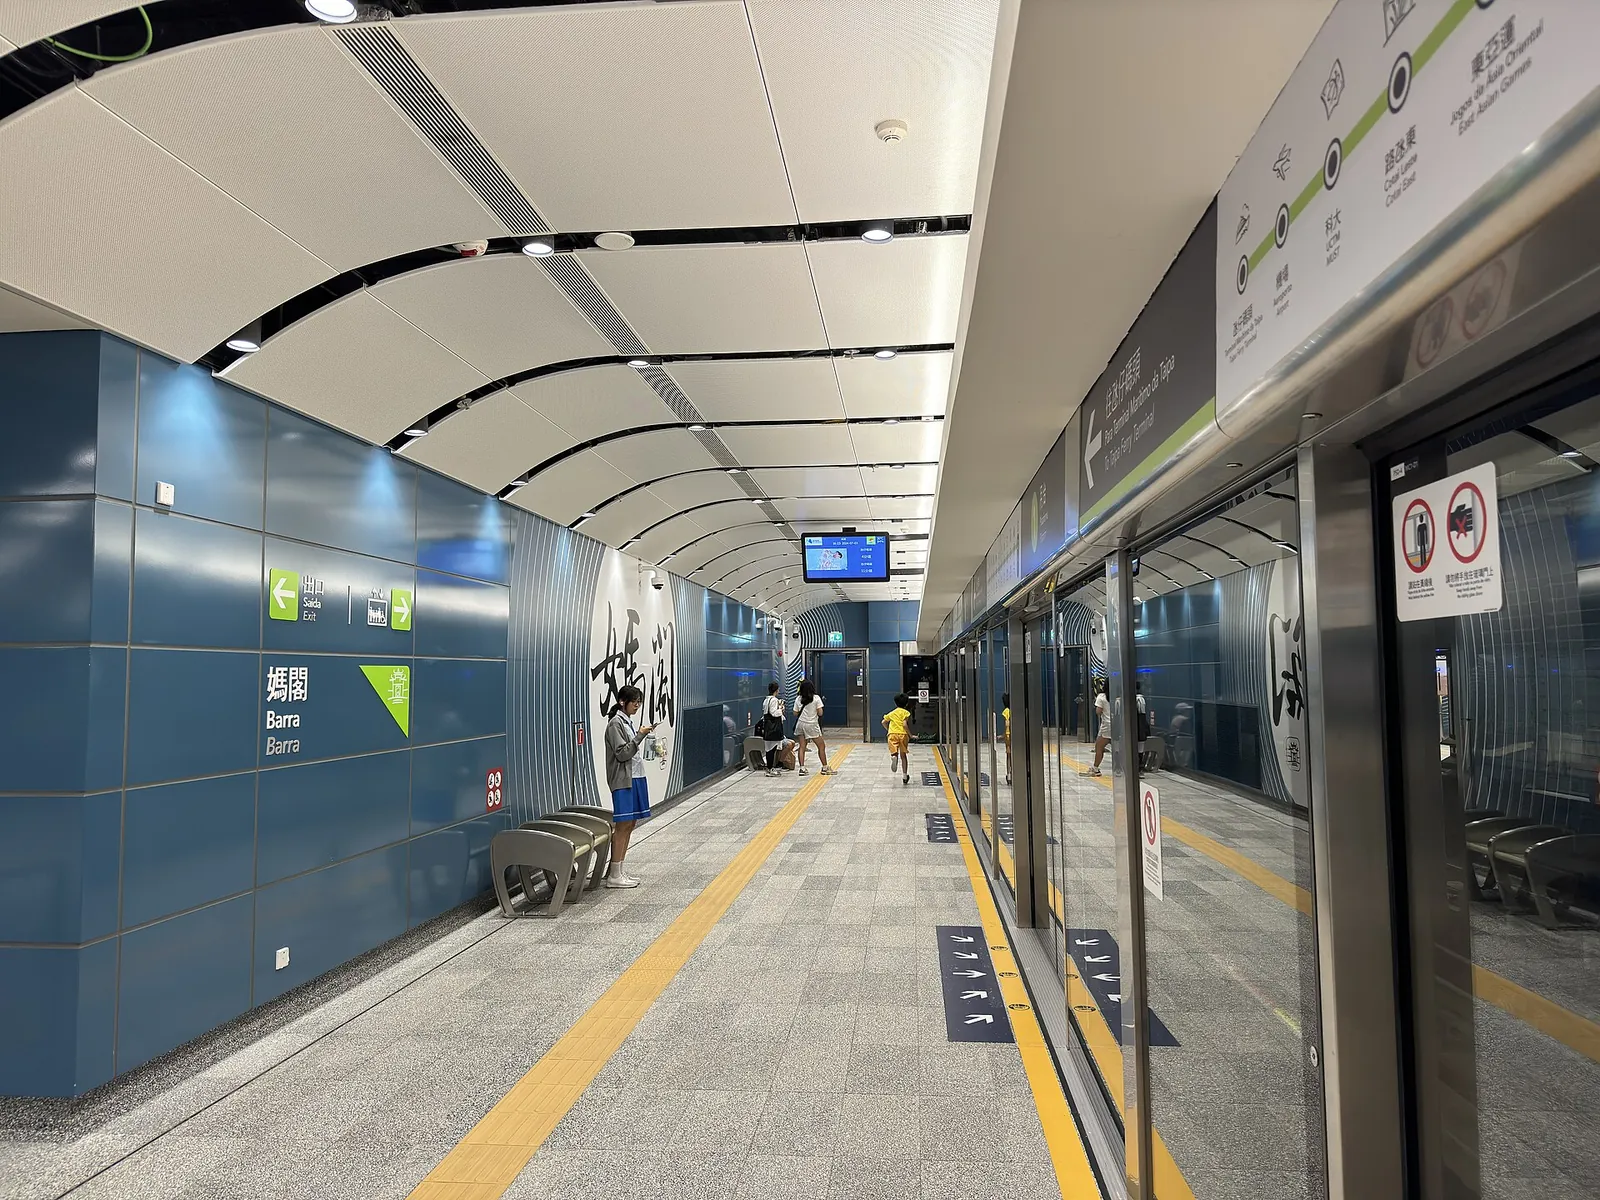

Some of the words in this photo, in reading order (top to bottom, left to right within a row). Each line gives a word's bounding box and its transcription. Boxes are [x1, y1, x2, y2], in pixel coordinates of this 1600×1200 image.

[1471, 13, 1516, 83] 東亞運
[1458, 112, 1475, 136] East
[1477, 89, 1499, 118] Asian
[1500, 56, 1532, 93] Games
[1450, 96, 1473, 126] Jogos
[1325, 208, 1342, 237] 科大
[1104, 428, 1113, 446] Para
[1160, 354, 1175, 383] Taipa
[301, 575, 325, 595] 出口
[303, 596, 322, 609] Saída
[303, 610, 317, 622] Exit
[266, 665, 309, 703] 媽閣
[266, 710, 301, 730] Barra
[265, 735, 301, 756] Barra
